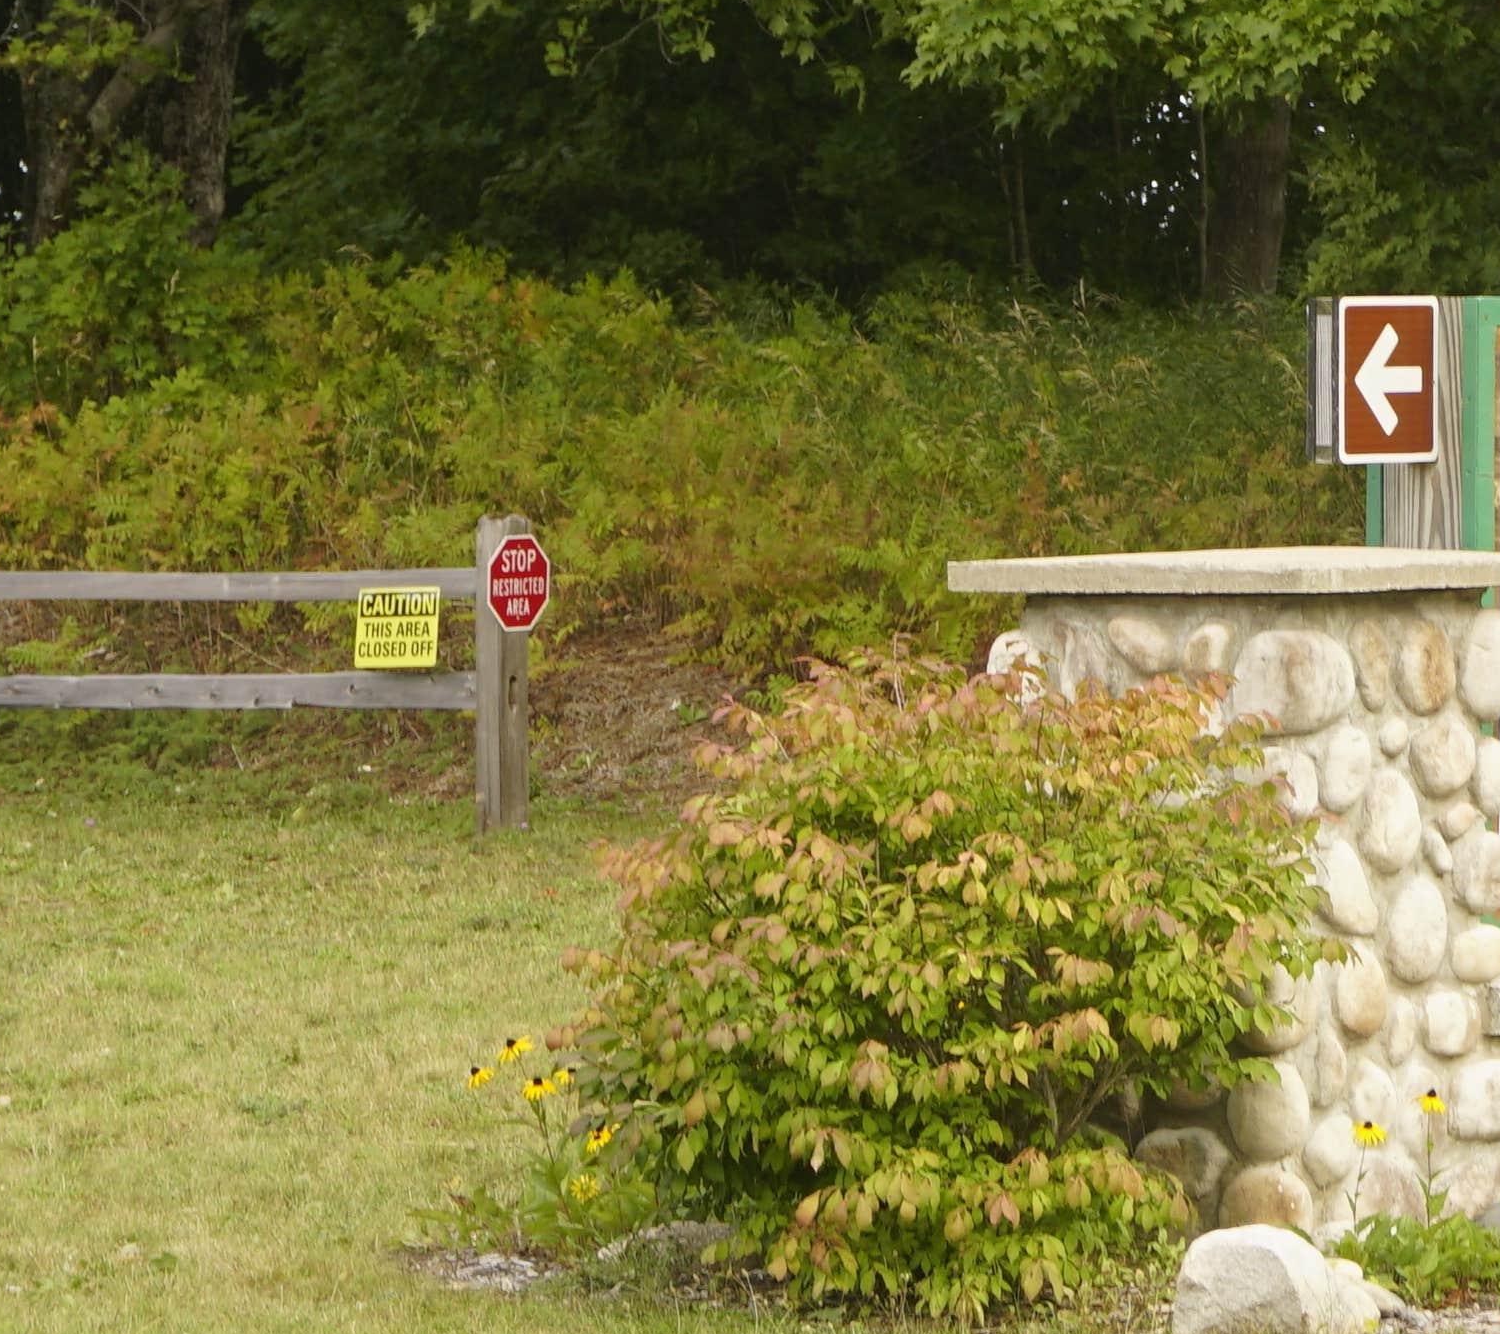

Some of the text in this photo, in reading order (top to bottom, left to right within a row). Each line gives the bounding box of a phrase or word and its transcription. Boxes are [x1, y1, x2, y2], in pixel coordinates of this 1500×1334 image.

[501, 549, 537, 573] STOP
[492, 577, 545, 597] RESTRICTED
[362, 594, 435, 616] CAUTION
[506, 599, 530, 616] AREA
[364, 621, 430, 639] THIS AREA
[358, 640, 434, 658] CLOSED OFF
